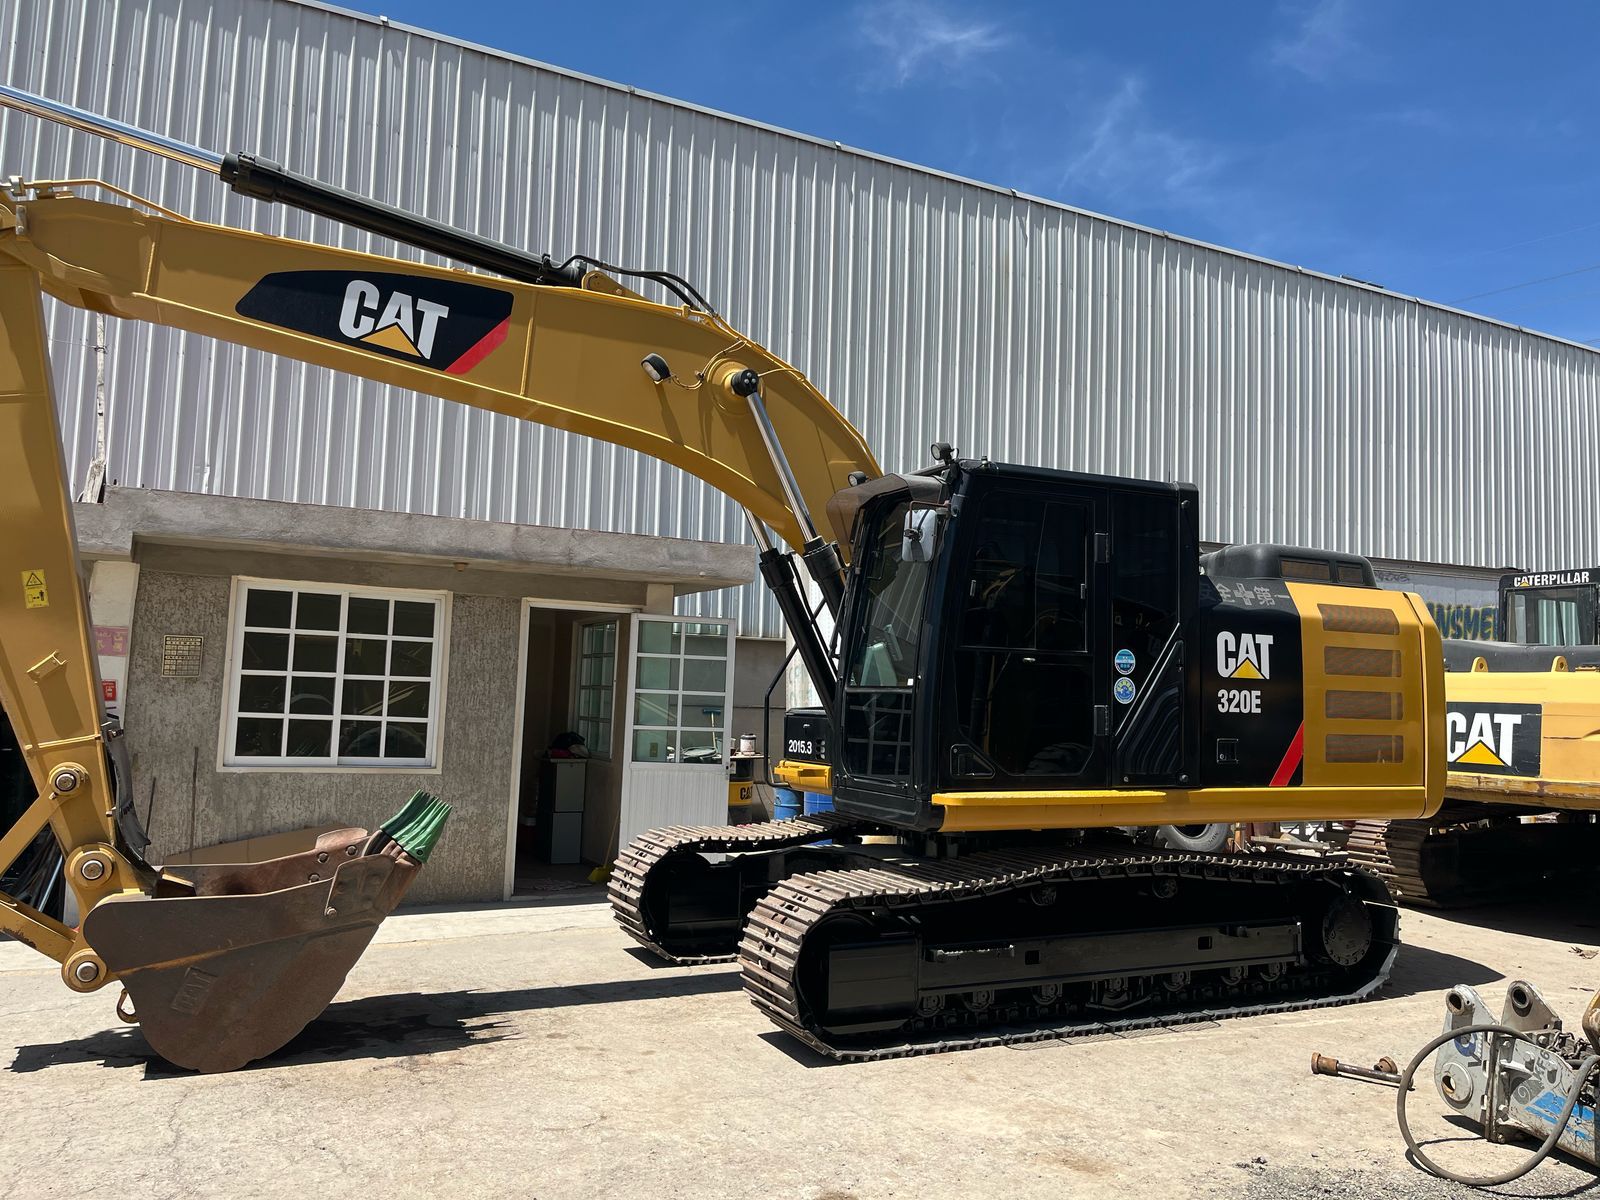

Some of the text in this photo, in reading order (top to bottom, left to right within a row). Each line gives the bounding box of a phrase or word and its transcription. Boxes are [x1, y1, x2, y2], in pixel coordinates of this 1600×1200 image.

[338, 279, 450, 360] CAT
[1513, 571, 1590, 588] CATERPILLAR
[1216, 630, 1274, 680] CAT
[1217, 689, 1262, 714] 320E
[788, 739, 813, 754] 2015.3
[1446, 711, 1522, 768] CAT
